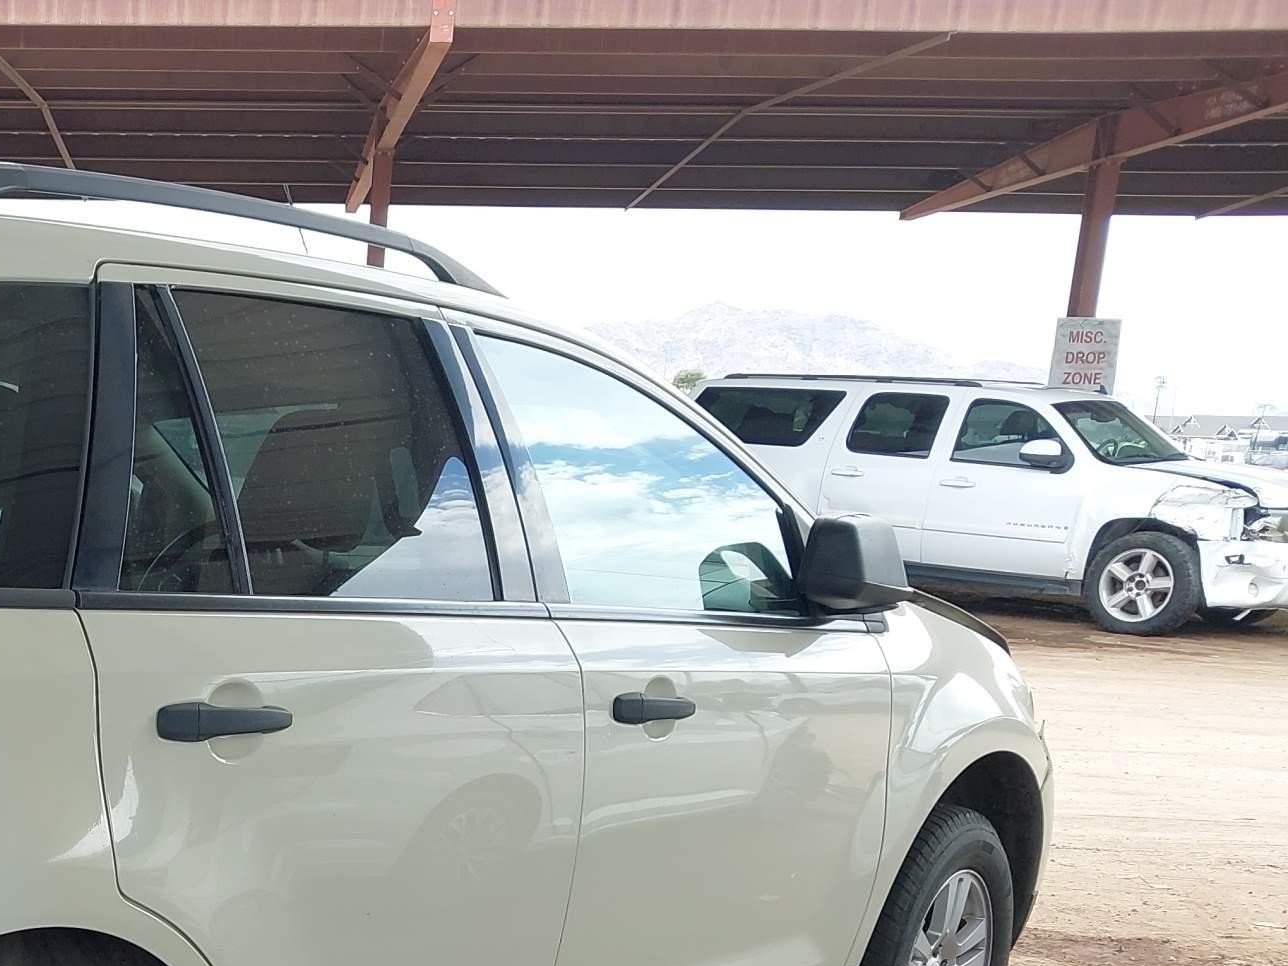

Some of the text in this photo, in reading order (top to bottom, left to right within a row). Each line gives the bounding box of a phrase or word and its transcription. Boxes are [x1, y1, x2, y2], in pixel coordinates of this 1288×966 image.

[1068, 330, 1107, 344] MISC.
[1064, 351, 1106, 365] DROP
[1062, 371, 1102, 385] ZONE
